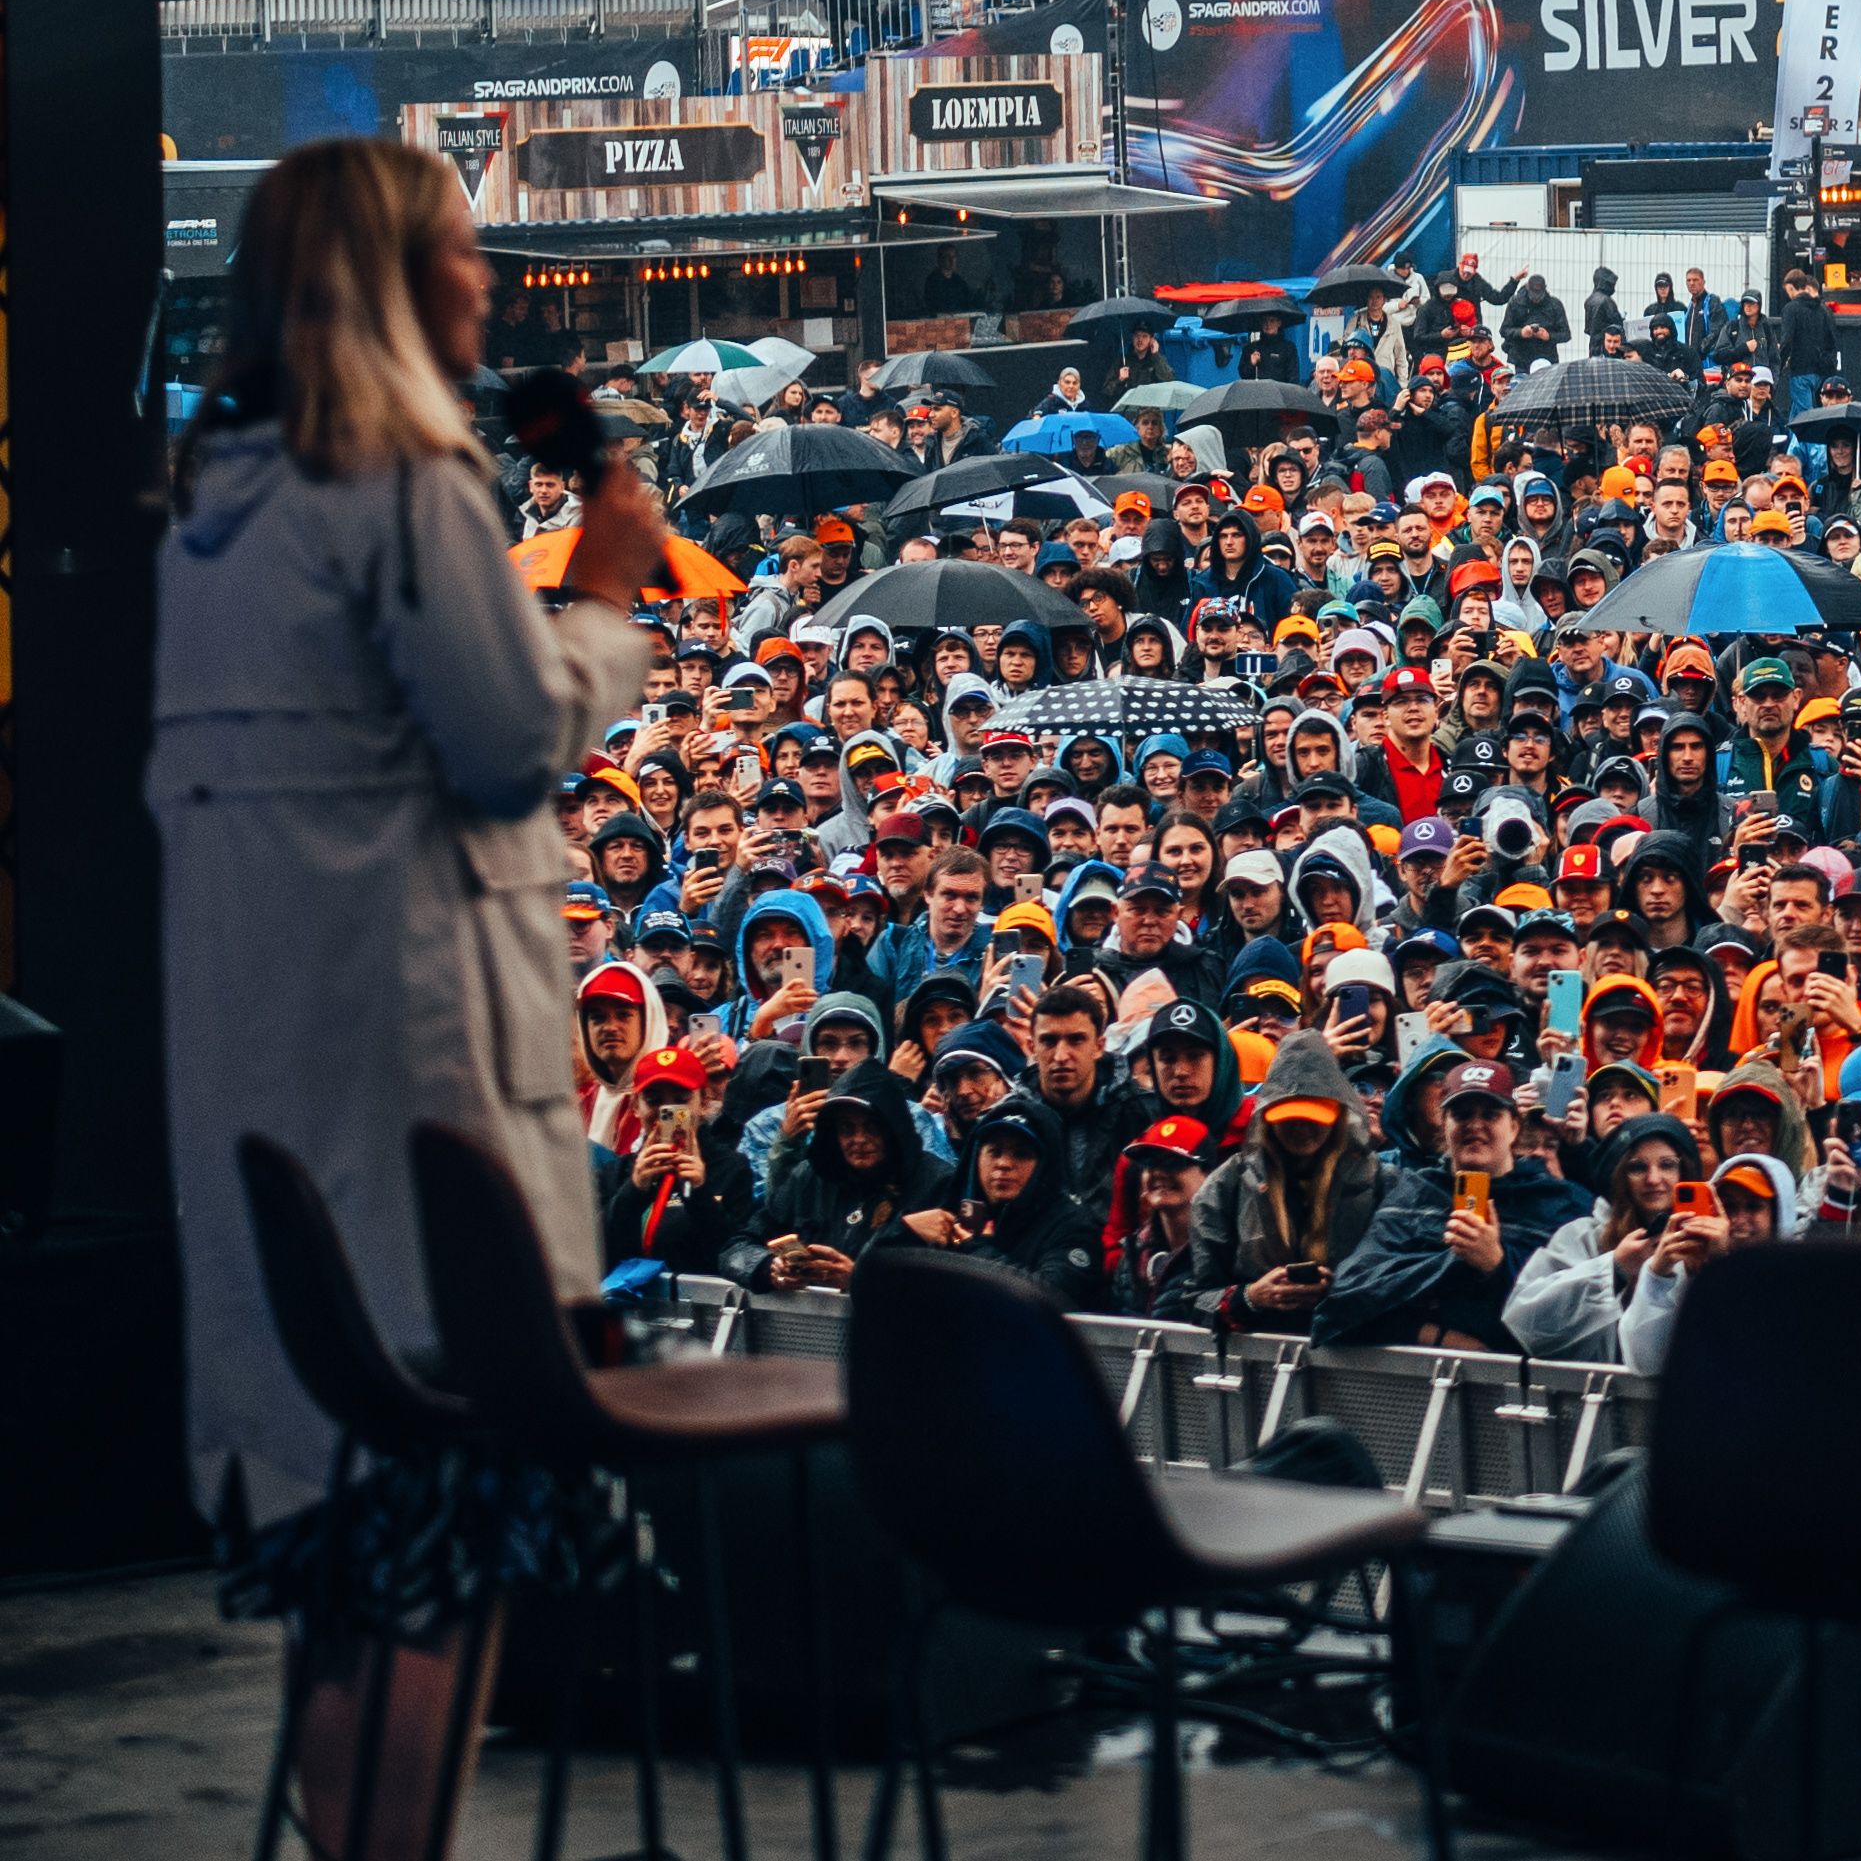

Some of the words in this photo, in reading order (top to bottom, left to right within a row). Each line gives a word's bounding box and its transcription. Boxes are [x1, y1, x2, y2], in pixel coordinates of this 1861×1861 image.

[1188, 0, 1321, 19] SPAGRANDPRIX.COM
[473, 75, 634, 99] SPAGRANDPRIX.COM
[1815, 75, 1834, 101] 2
[931, 95, 1042, 129] LOEMPIA
[784, 119, 816, 134] ITALIAN
[818, 118, 841, 134] STYLE
[439, 131, 472, 147] ITALIAN
[475, 129, 502, 146] STYLE
[604, 138, 684, 173] PIZZA
[166, 229, 217, 239] ETRONAS
